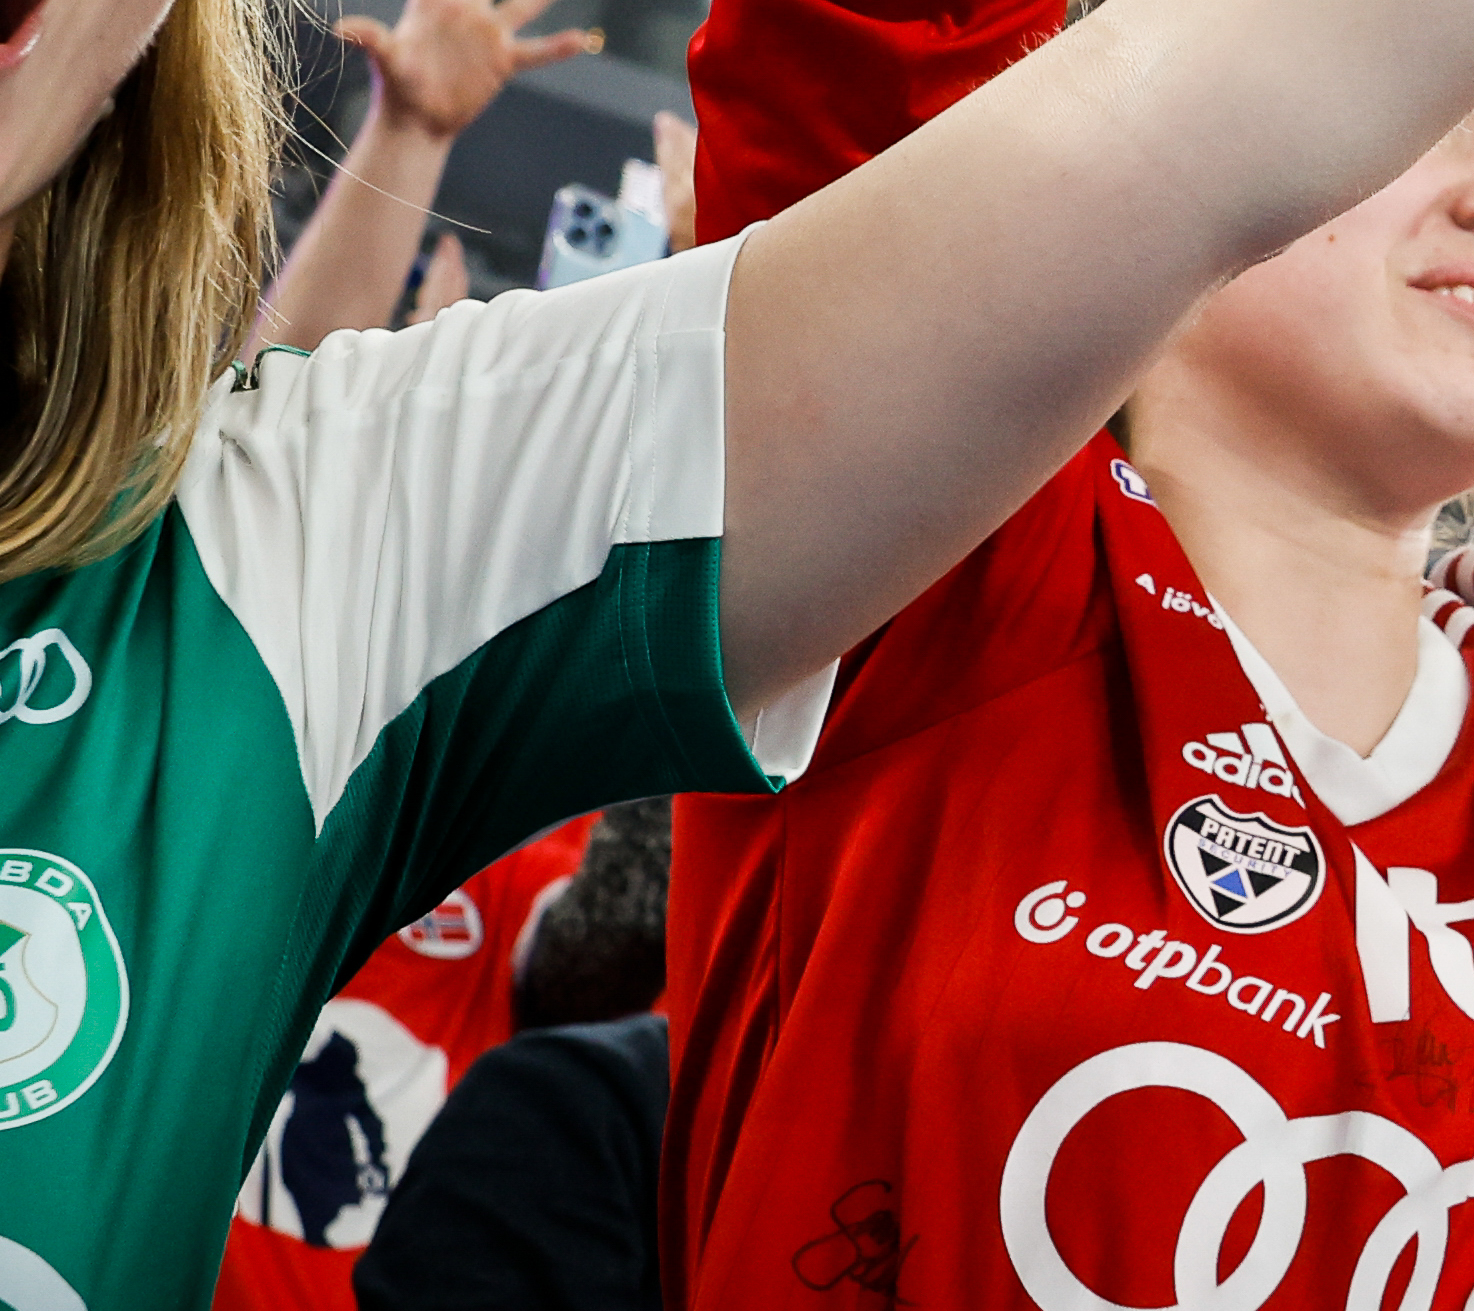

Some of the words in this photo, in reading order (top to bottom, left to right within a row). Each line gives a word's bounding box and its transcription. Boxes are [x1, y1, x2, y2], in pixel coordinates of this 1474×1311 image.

[1198, 838, 1292, 878] SECURITY
[1199, 817, 1302, 868] PATENT
[1085, 919, 1342, 1049] otpbank
